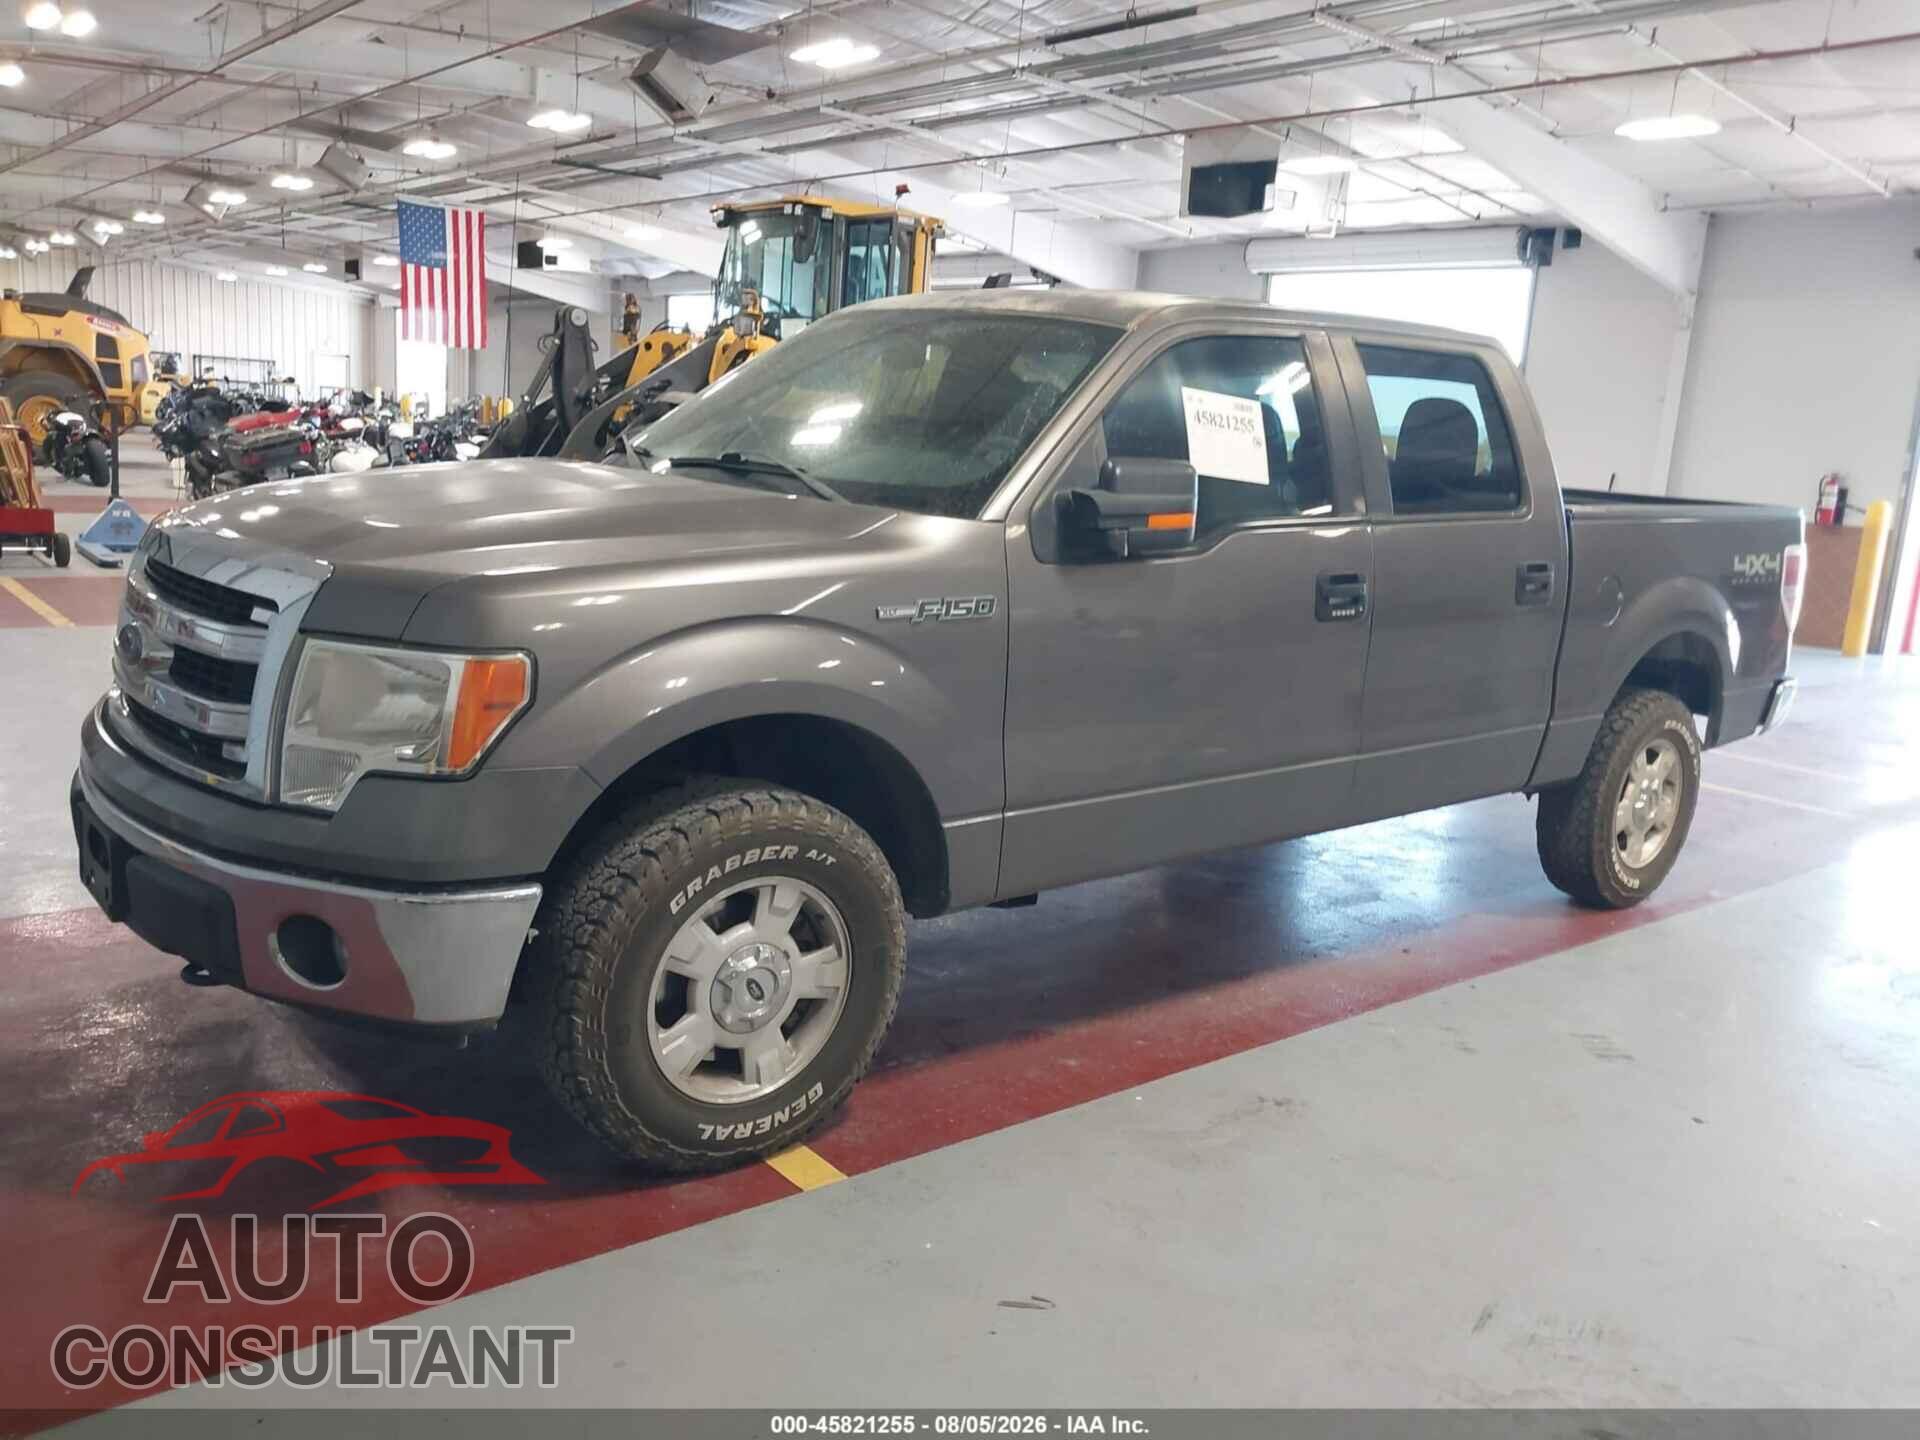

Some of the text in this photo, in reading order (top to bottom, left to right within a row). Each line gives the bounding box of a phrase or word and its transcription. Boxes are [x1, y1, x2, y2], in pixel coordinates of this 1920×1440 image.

[669, 845, 837, 915] GRABBER A/T
[697, 1081, 824, 1141] GENERAL
